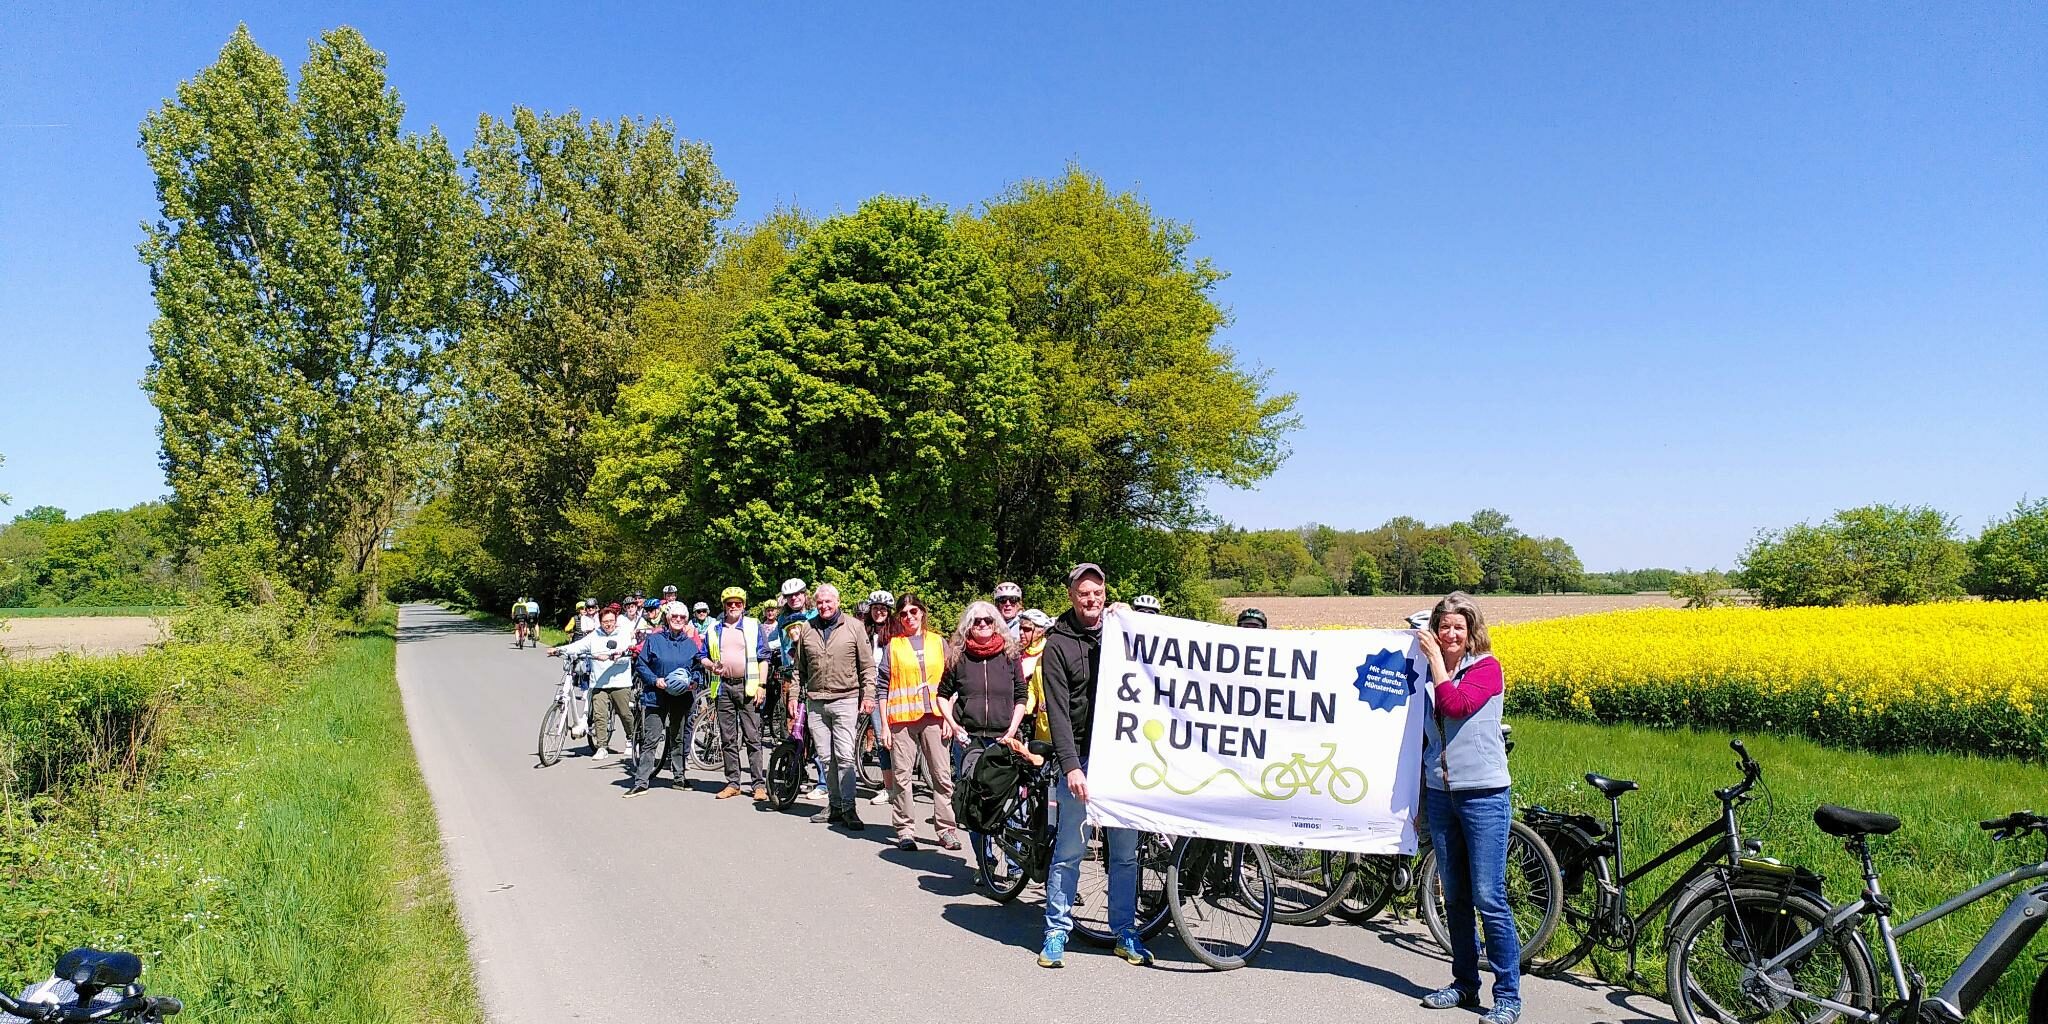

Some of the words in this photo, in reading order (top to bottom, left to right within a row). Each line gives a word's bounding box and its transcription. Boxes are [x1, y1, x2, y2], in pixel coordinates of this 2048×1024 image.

[1122, 631, 1318, 680] WANDELN
[1369, 665, 1380, 673] Mit
[1117, 672, 1142, 703] &
[1153, 676, 1337, 724] HANDELN
